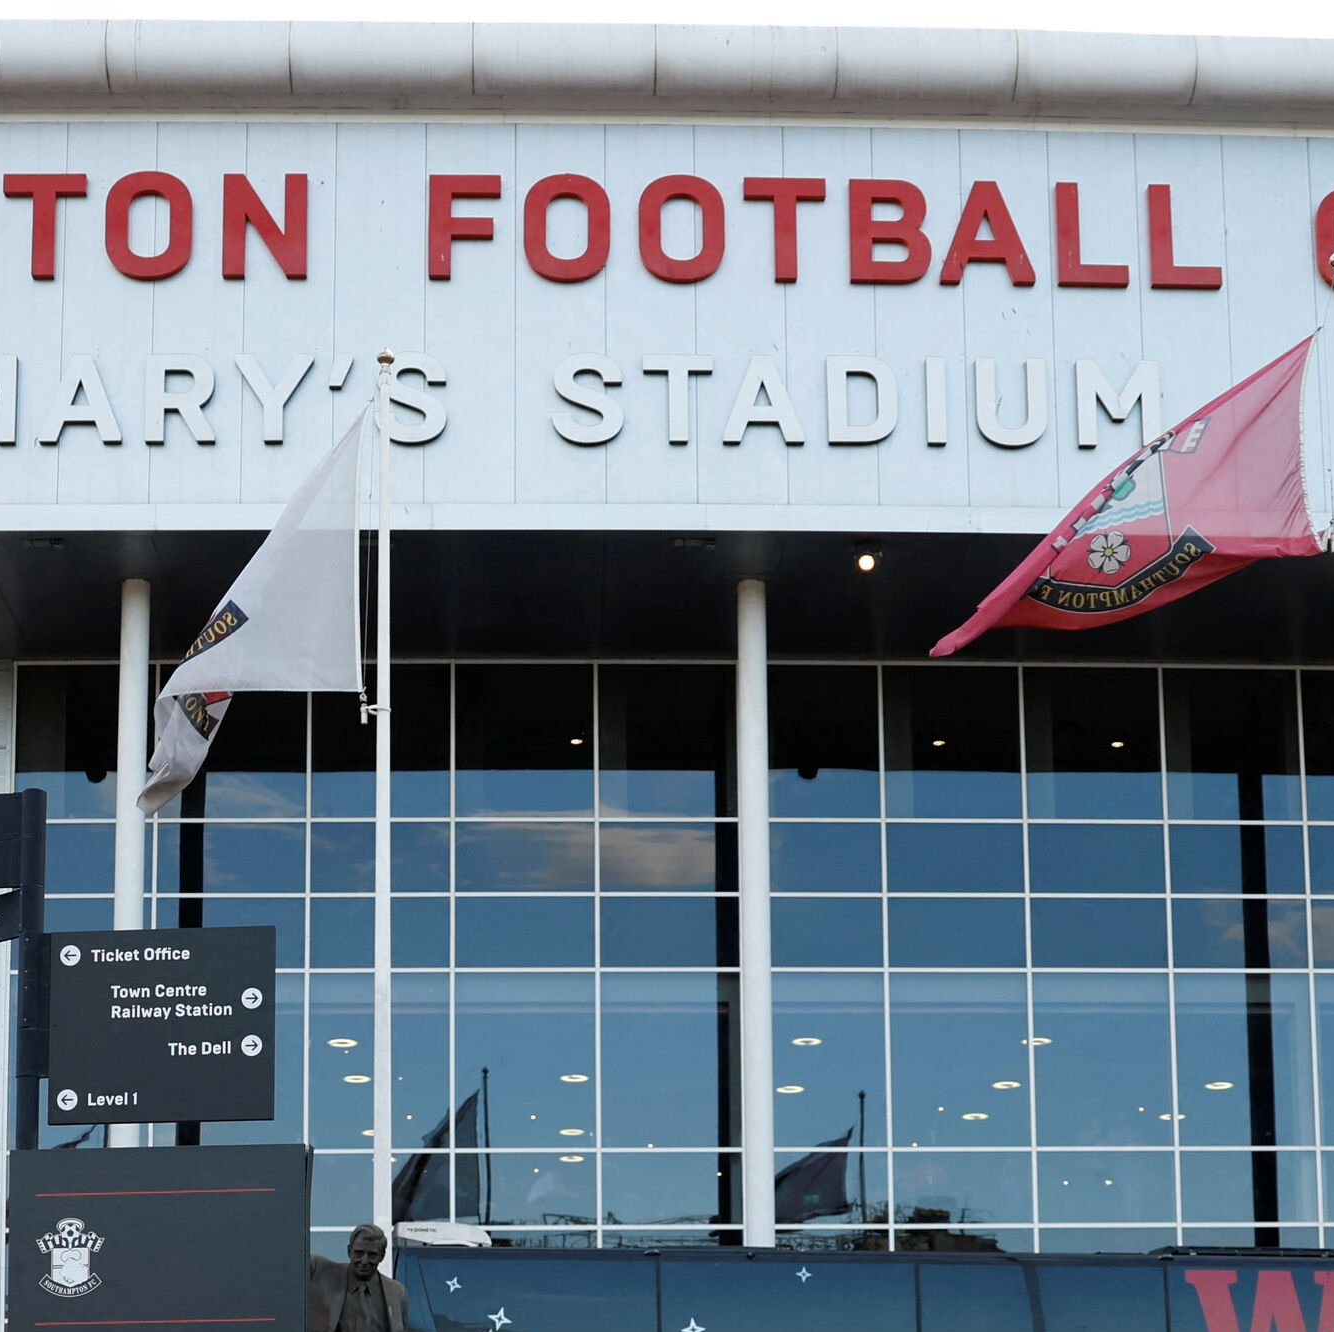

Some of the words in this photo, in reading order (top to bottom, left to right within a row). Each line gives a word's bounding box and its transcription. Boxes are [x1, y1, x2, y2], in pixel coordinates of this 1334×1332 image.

[427, 174, 1222, 290] FOOTBALL
[551, 353, 1161, 450] STADIUM
[91, 949, 139, 962] Ticket
[143, 947, 190, 962] Office
[111, 985, 151, 999] Town
[154, 984, 207, 997] Centre
[111, 1003, 171, 1021] Railway
[175, 1002, 233, 1018] Station
[168, 1042, 197, 1056] The
[201, 1040, 232, 1055] Dell
[87, 1092, 126, 1107] Level
[132, 1093, 137, 1105] 1
[43, 1279, 87, 1295] SOUTHAMPTON
[88, 1278, 97, 1288] FC
